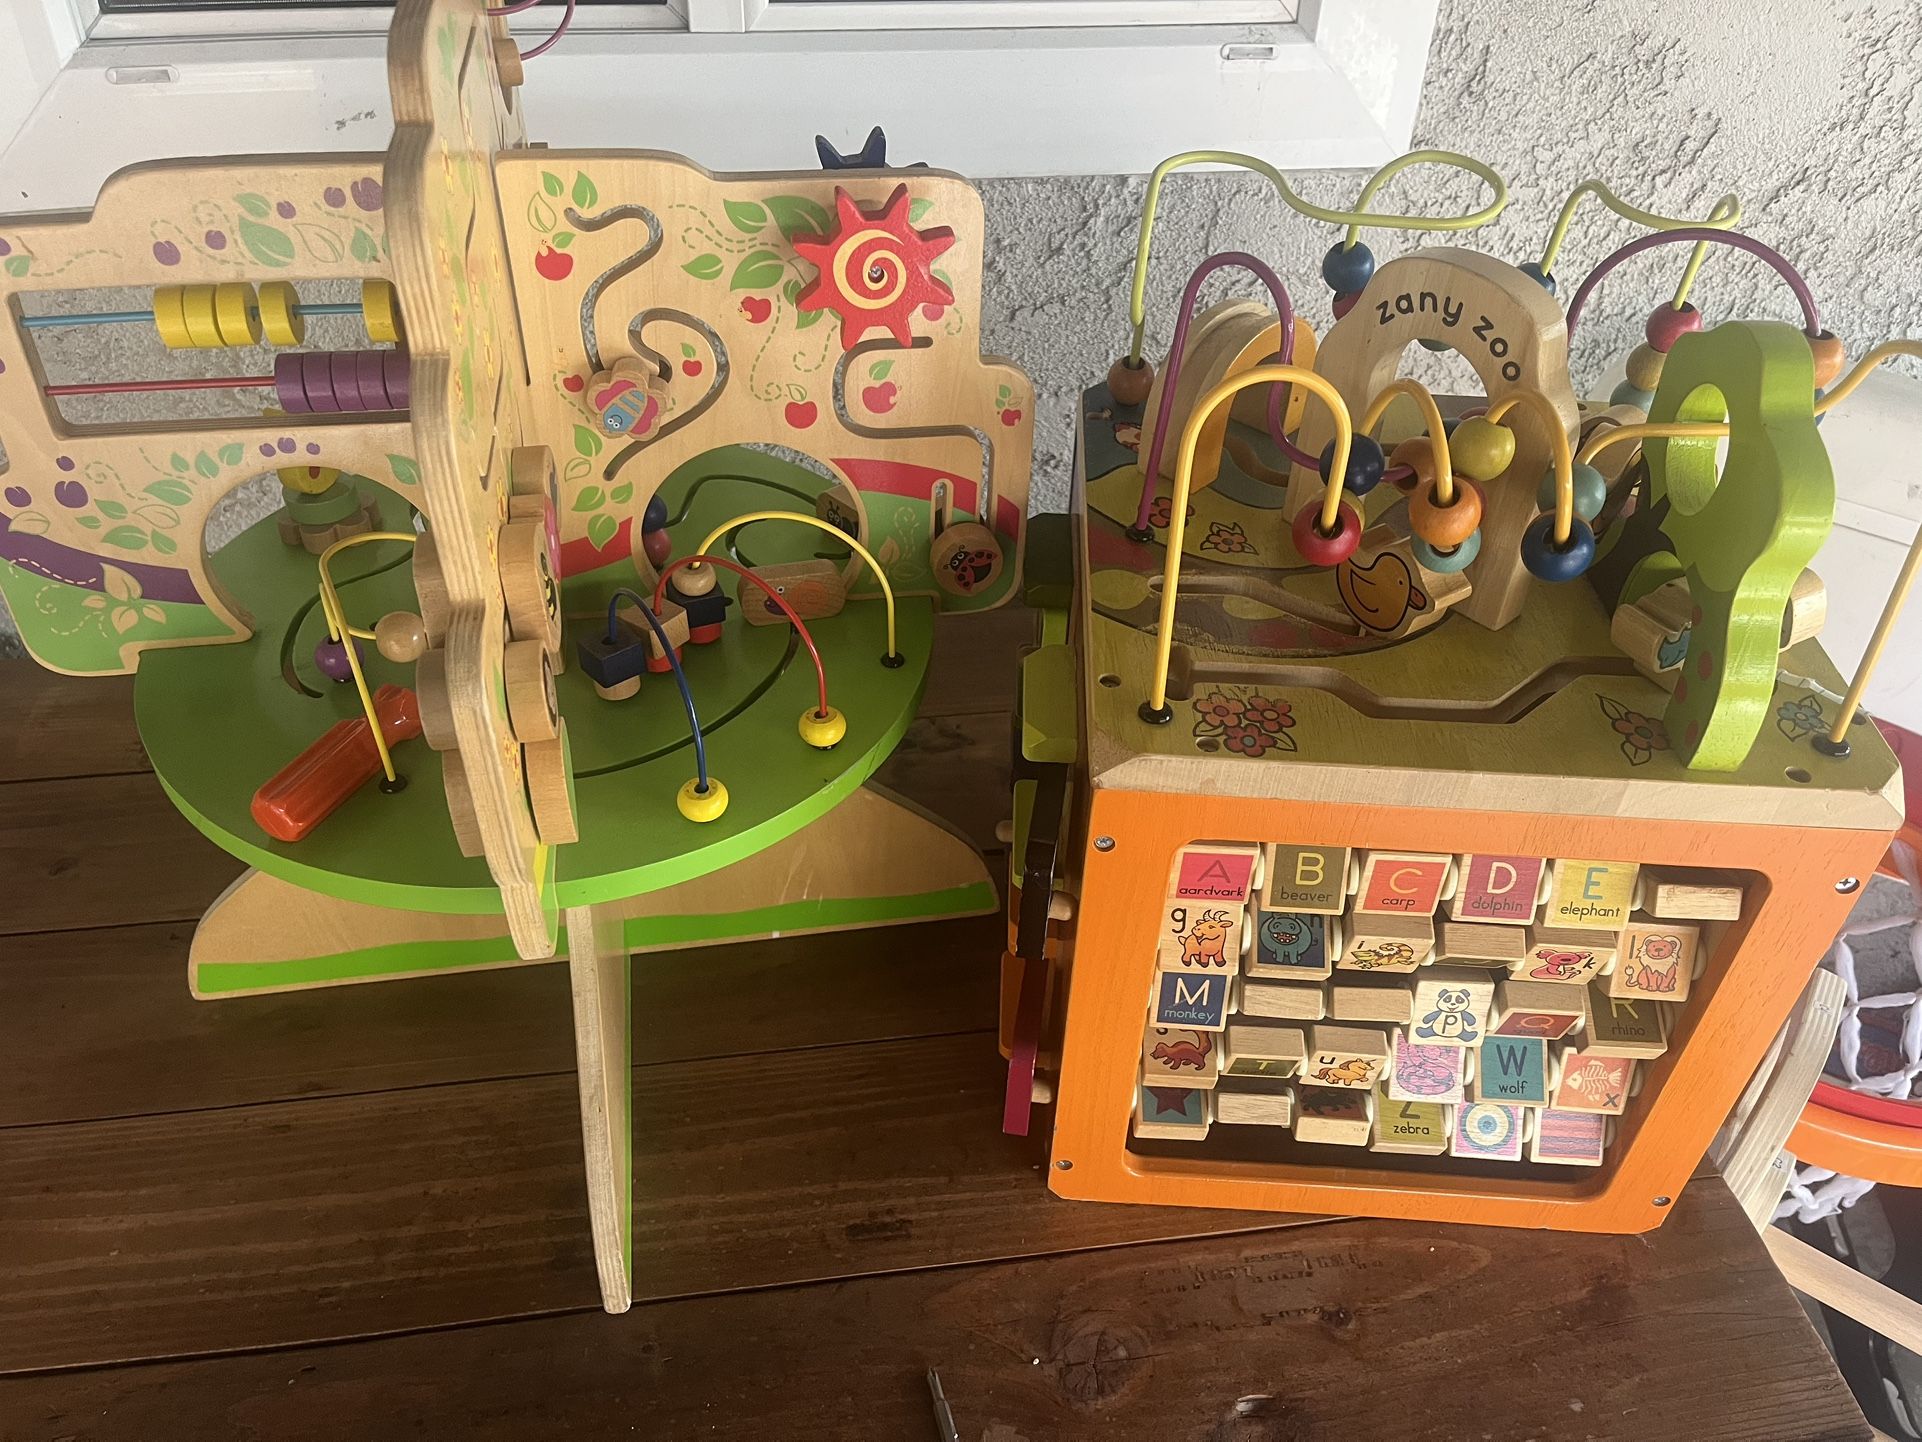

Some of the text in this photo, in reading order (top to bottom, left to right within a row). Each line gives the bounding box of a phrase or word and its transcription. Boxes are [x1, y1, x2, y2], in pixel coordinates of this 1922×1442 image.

[1376, 291, 1521, 382] zany zoo
[1197, 859, 1231, 884] A
[1295, 852, 1325, 886] B
[1486, 861, 1517, 895] D
[1389, 868, 1423, 894] C
[1582, 866, 1609, 900] E
[1178, 886, 1245, 898] aardvark
[1280, 886, 1333, 903] beaver
[1381, 897, 1416, 911] carp
[1471, 896, 1523, 913] dolphin
[1560, 901, 1620, 921] elephant
[1170, 907, 1187, 934] g
[1582, 956, 1596, 970] k
[1174, 977, 1210, 1007] M
[1164, 1006, 1215, 1025] monkey
[1520, 1015, 1555, 1030] Q
[1611, 1021, 1646, 1036] rhino
[1256, 1060, 1277, 1070] T
[1496, 1043, 1528, 1078] W
[1498, 1080, 1528, 1095] wolf
[1393, 1121, 1430, 1136] zebra
